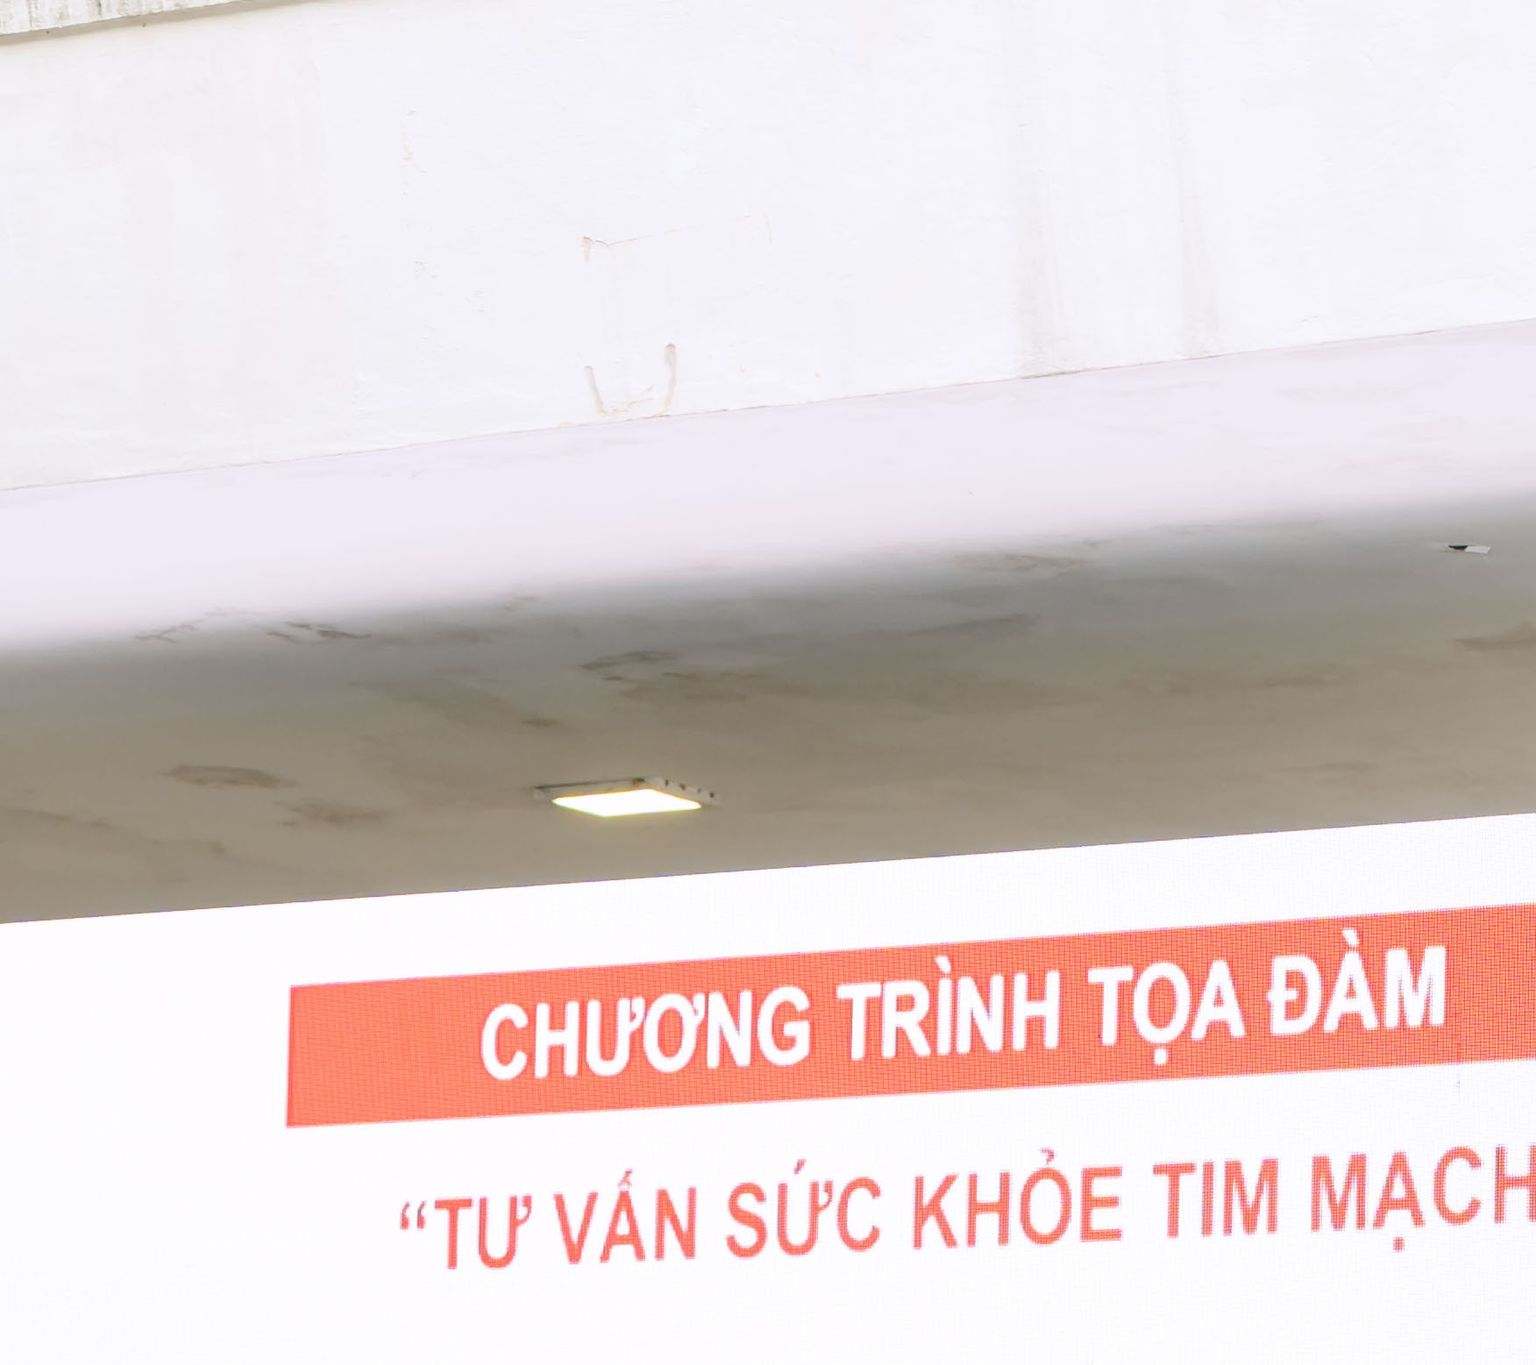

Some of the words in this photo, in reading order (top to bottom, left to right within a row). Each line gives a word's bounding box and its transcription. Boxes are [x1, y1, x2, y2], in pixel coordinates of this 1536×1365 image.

[480, 985, 811, 1080] CHƯƠNG
[836, 953, 1060, 1061] TRÌNH
[1087, 960, 1246, 1066] TỌA
[1264, 928, 1447, 1036] ĐÀM
[553, 1166, 697, 1265] VẤN
[726, 1159, 881, 1258] SỨC
[913, 1148, 1123, 1250] KHỎE
[1152, 1158, 1279, 1239] TIM
